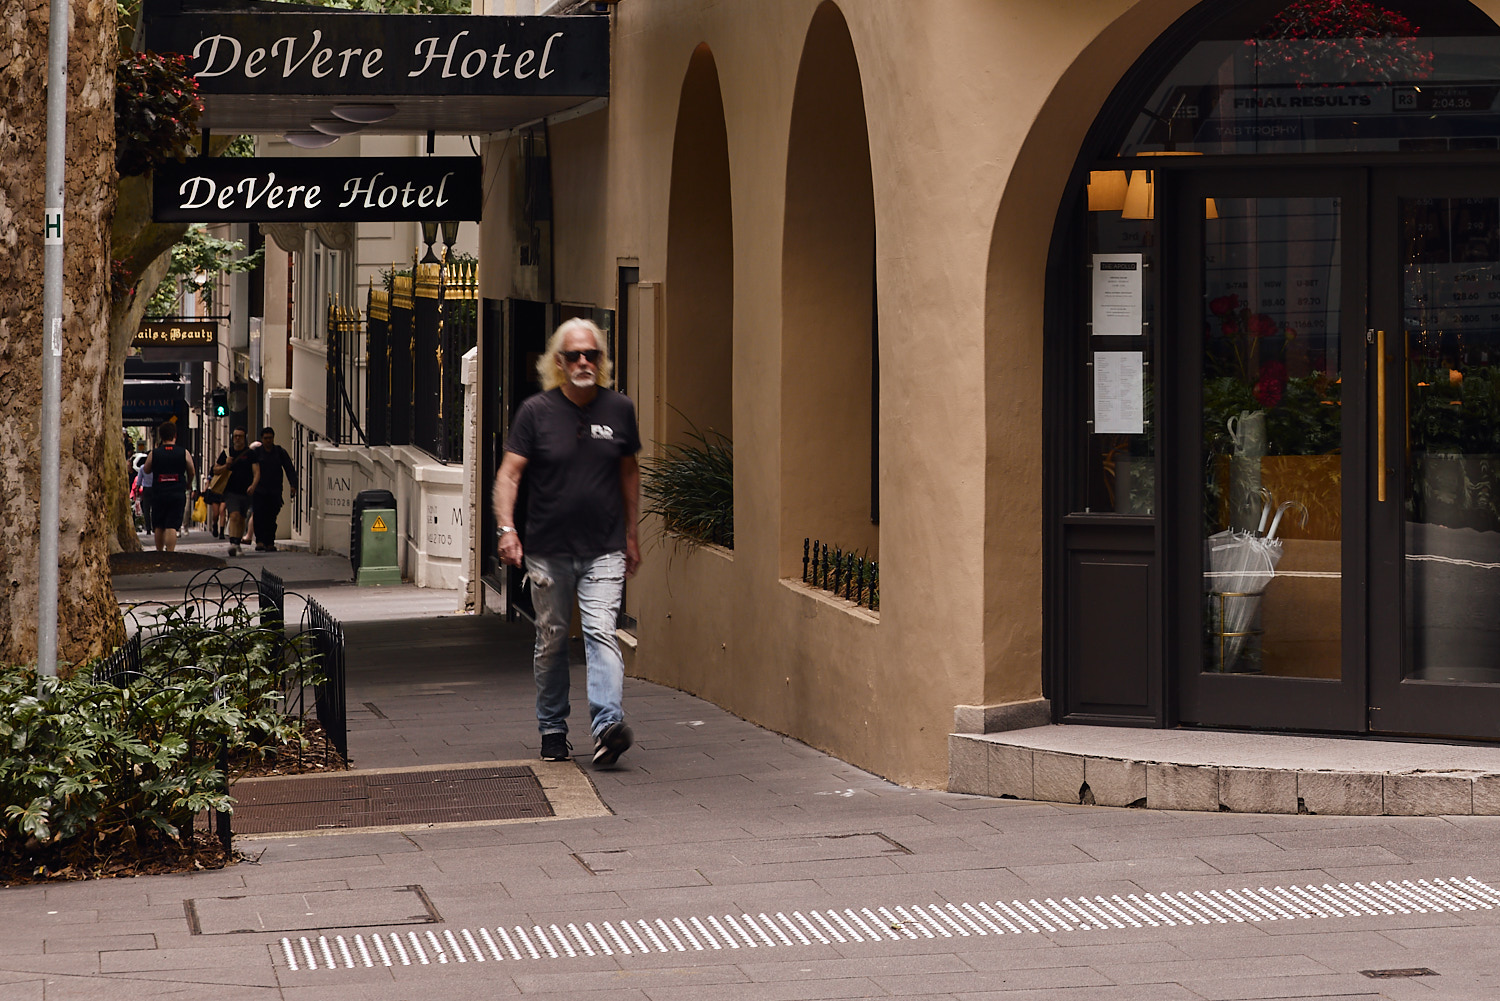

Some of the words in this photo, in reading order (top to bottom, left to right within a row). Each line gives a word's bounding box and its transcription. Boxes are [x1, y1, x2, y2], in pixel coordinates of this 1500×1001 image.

[193, 29, 384, 79] DeVere
[409, 30, 563, 81] Hotel
[1234, 96, 1287, 109] FINAL
[1290, 94, 1371, 108] RESULTS
[1398, 94, 1413, 105] R3
[1432, 98, 1471, 109] 2:04.36
[1216, 127, 1242, 137] TAB
[1244, 125, 1298, 137] TROPHY
[179, 172, 322, 209] DeVere
[339, 171, 455, 209] Hotel
[45, 213, 61, 238] H
[134, 327, 159, 340] ails
[170, 328, 213, 342] Beauty
